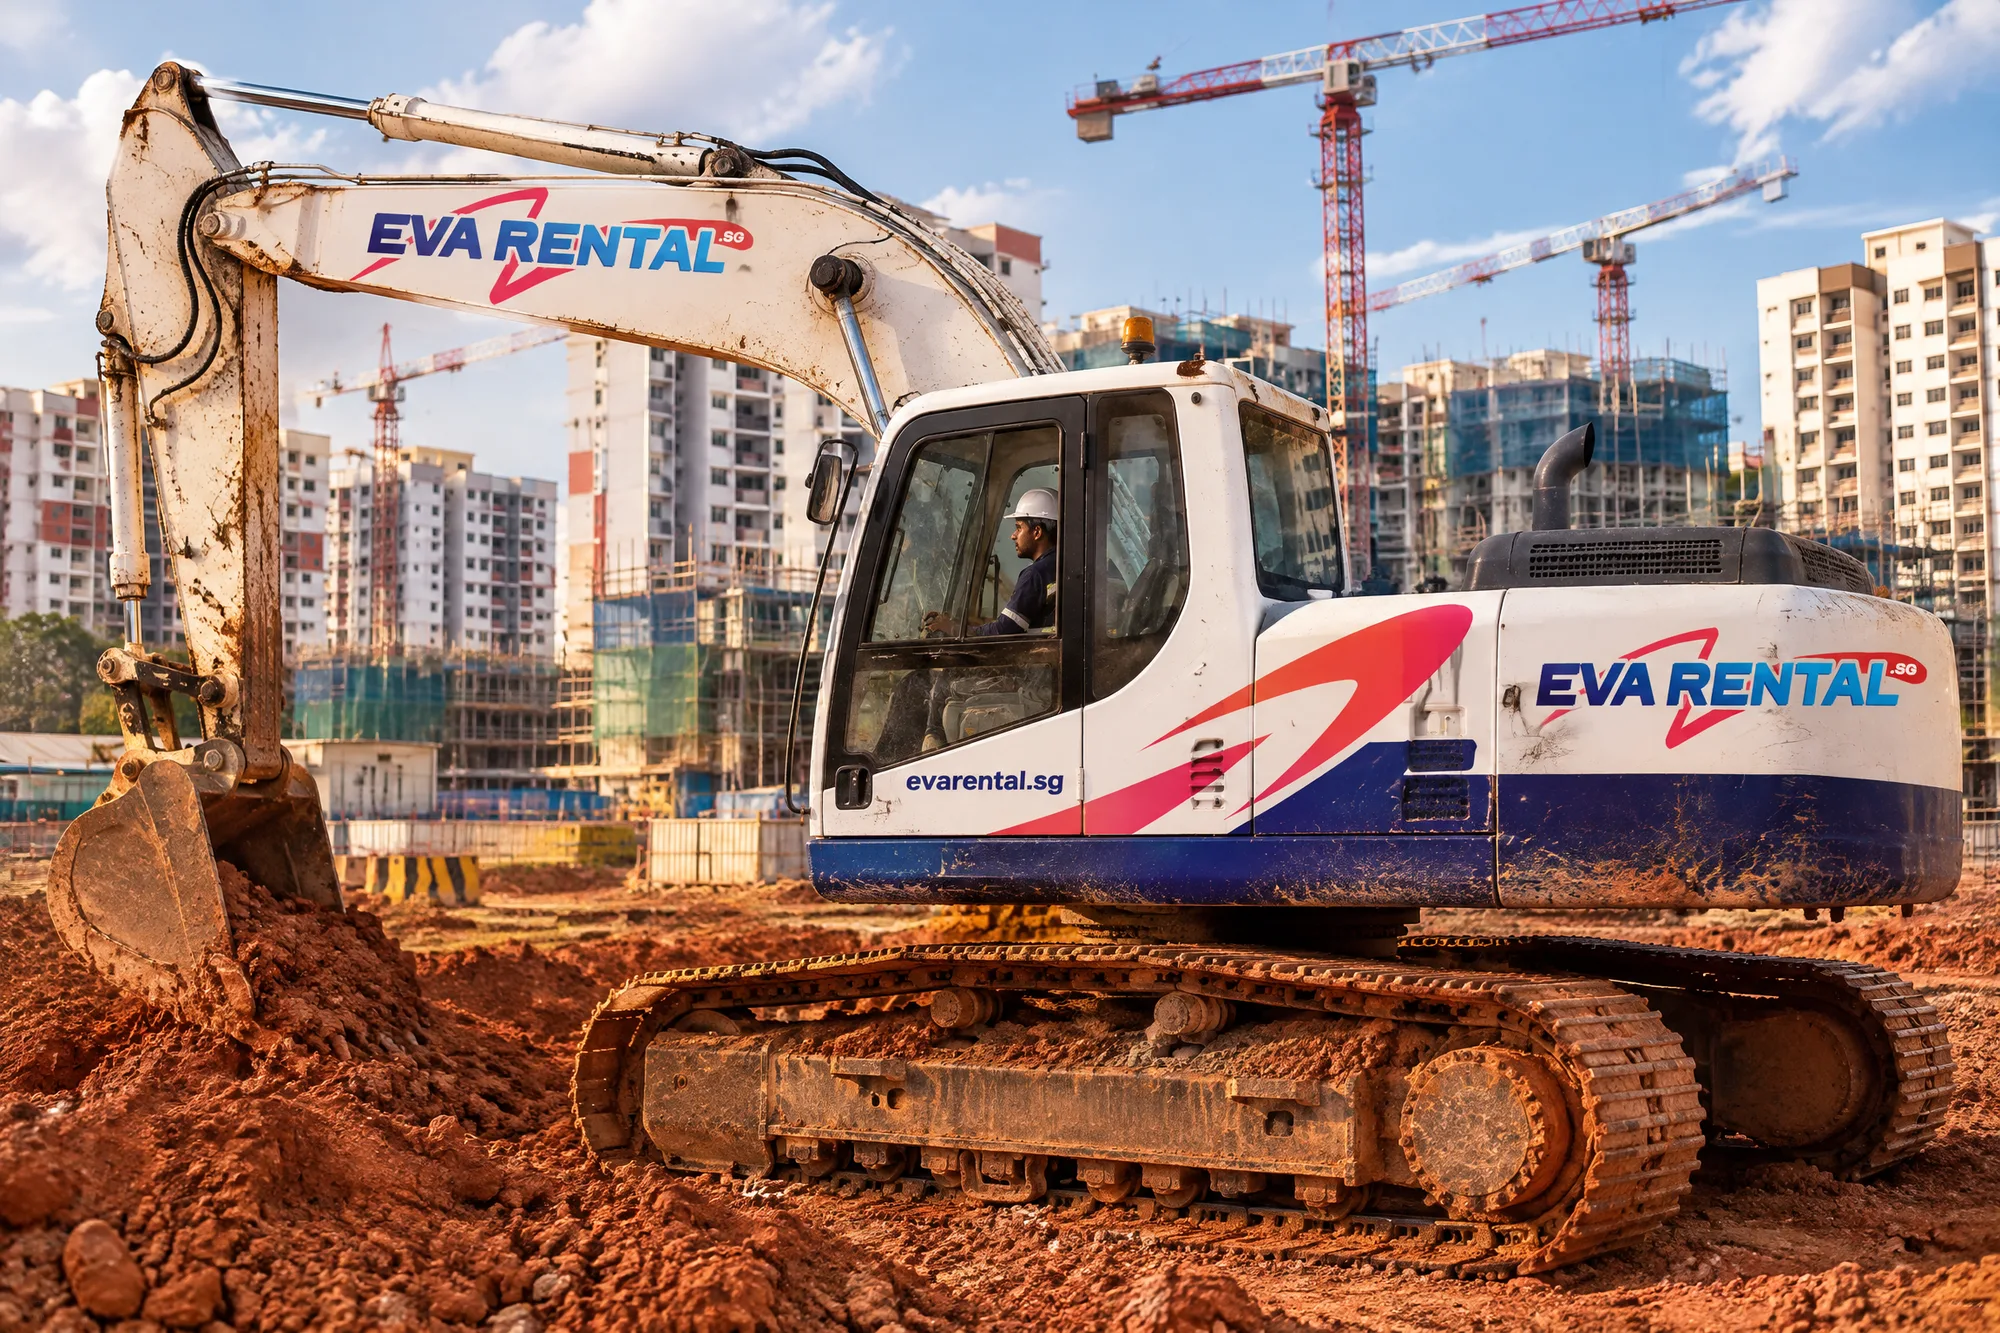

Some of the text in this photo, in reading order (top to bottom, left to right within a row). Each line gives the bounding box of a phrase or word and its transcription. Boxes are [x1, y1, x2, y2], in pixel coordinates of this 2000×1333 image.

[367, 212, 745, 274] EVA RENTAL .SG
[1536, 662, 1917, 706] EVA RENTAL .SG
[906, 770, 1064, 795] evarental.sg
